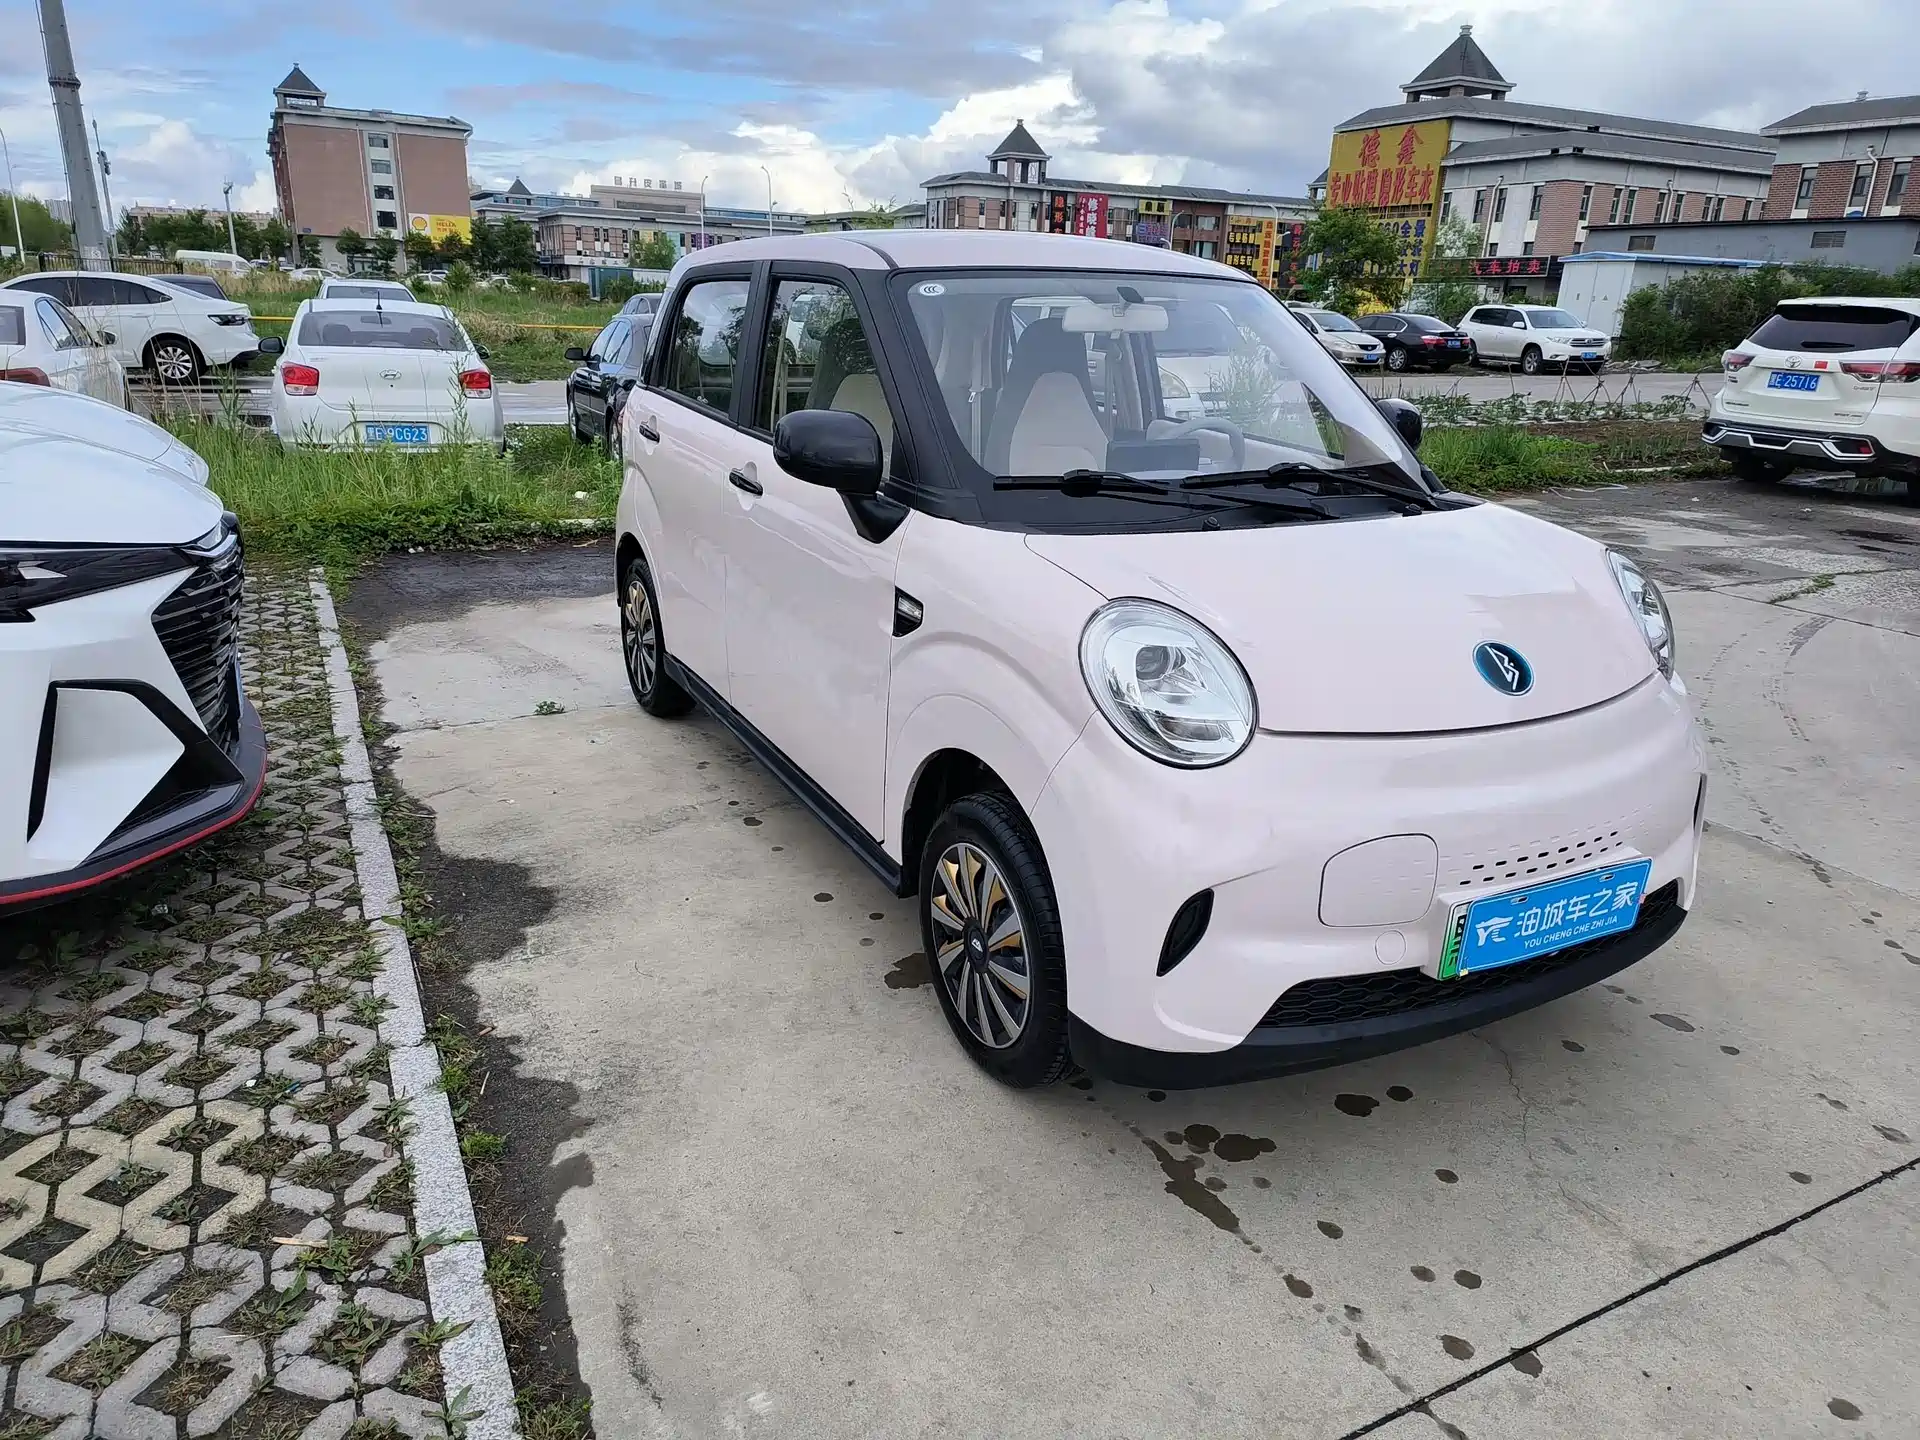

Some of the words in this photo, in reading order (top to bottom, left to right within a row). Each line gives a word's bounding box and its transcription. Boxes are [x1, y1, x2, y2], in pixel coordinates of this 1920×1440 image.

[1514, 881, 1638, 938] 油城车之家
[1524, 937, 1542, 949] YOU
[1543, 930, 1572, 944] CHENG
[1573, 923, 1590, 936] CHE
[1591, 919, 1604, 931] ZHI
[1605, 914, 1618, 928] JIA
